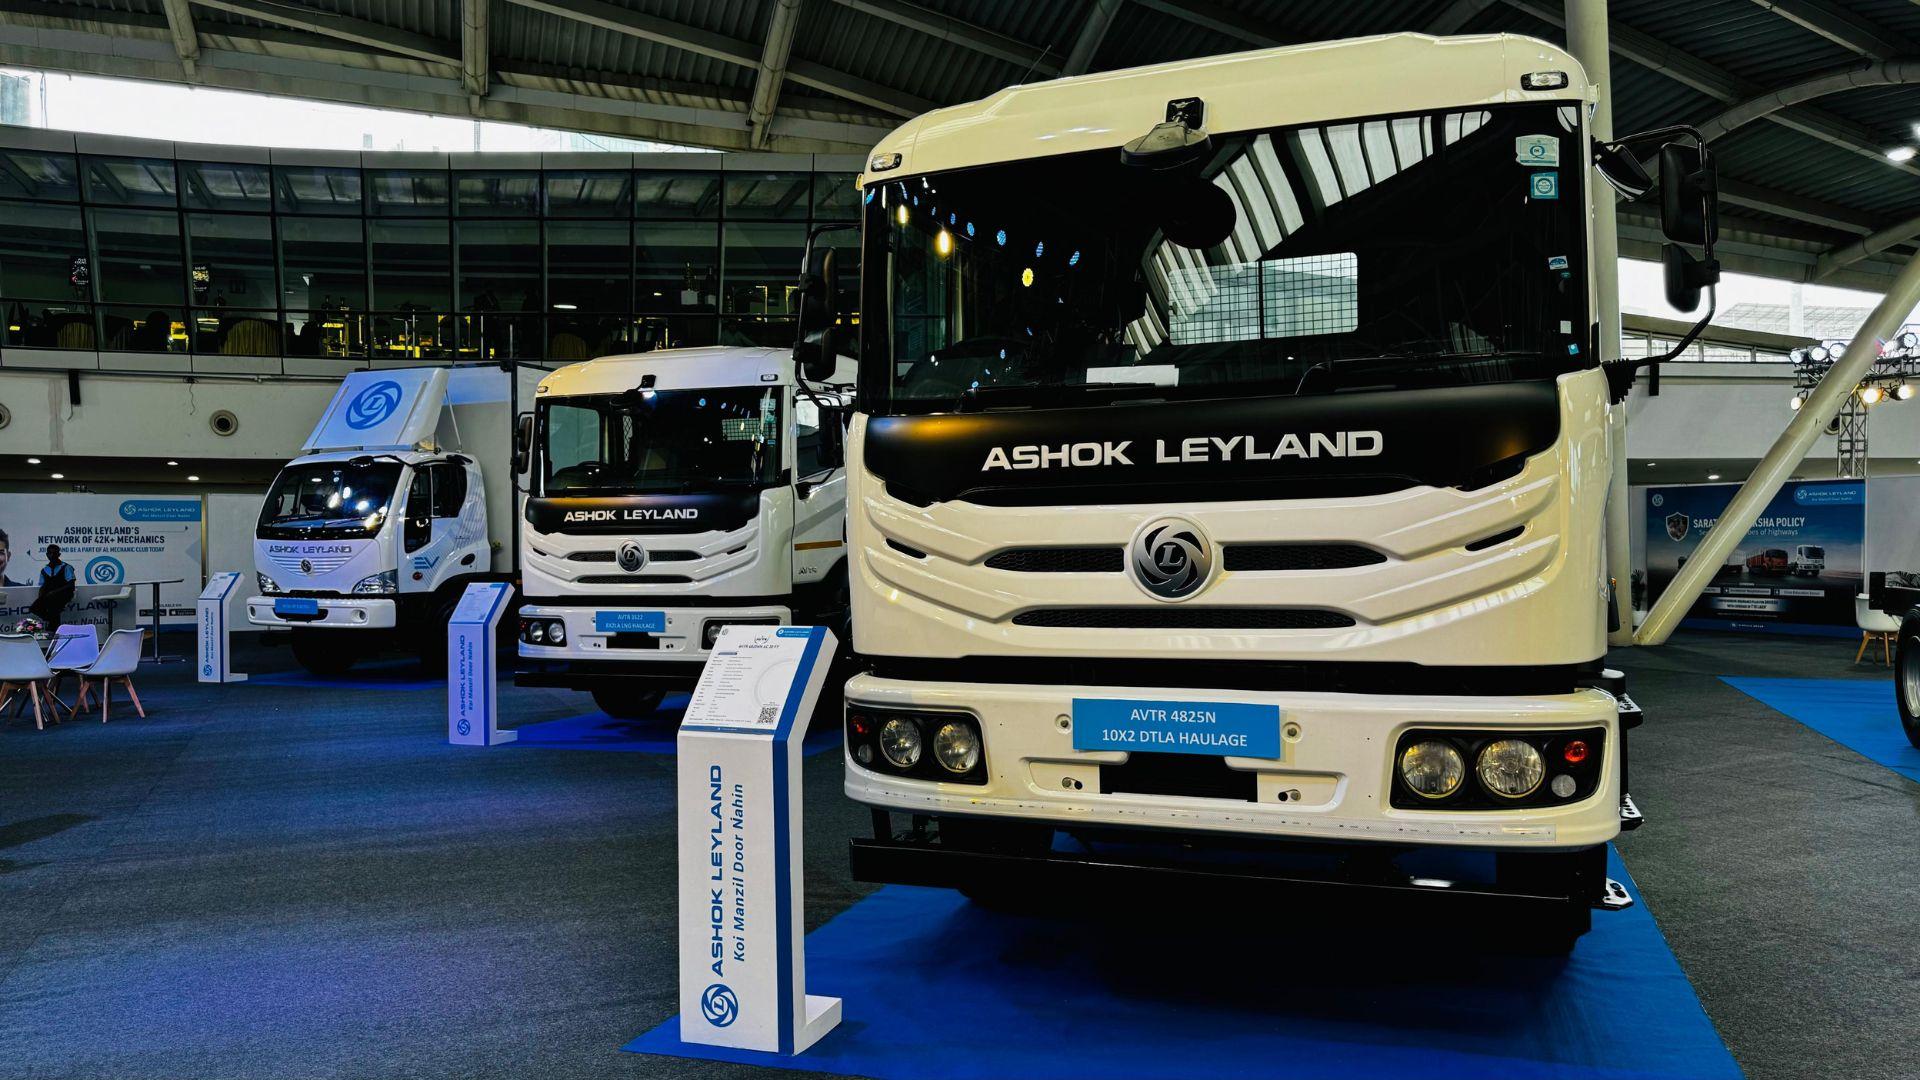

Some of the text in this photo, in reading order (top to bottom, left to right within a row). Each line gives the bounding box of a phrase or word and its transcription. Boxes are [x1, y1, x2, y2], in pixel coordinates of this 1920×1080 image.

[981, 431, 1383, 471] ASHOK LEYLAND
[564, 508, 698, 522] ASHOK LEYLAND
[1776, 517, 1805, 528] POLICY
[64, 526, 140, 535] ASHOK LEYLAND'S
[1760, 528, 1768, 536] of
[1768, 527, 1798, 538] highways
[38, 535, 165, 544] NETWORK OF 42K+ MECHANICS
[414, 556, 439, 569] EV
[1130, 709, 1216, 724] AVTR 4825N
[1102, 729, 1248, 747] 10X2 DTLA HAULAGE
[710, 765, 723, 977] ASHOK LEYLAND
[730, 784, 745, 962] Koi Manzil Door Nahin
